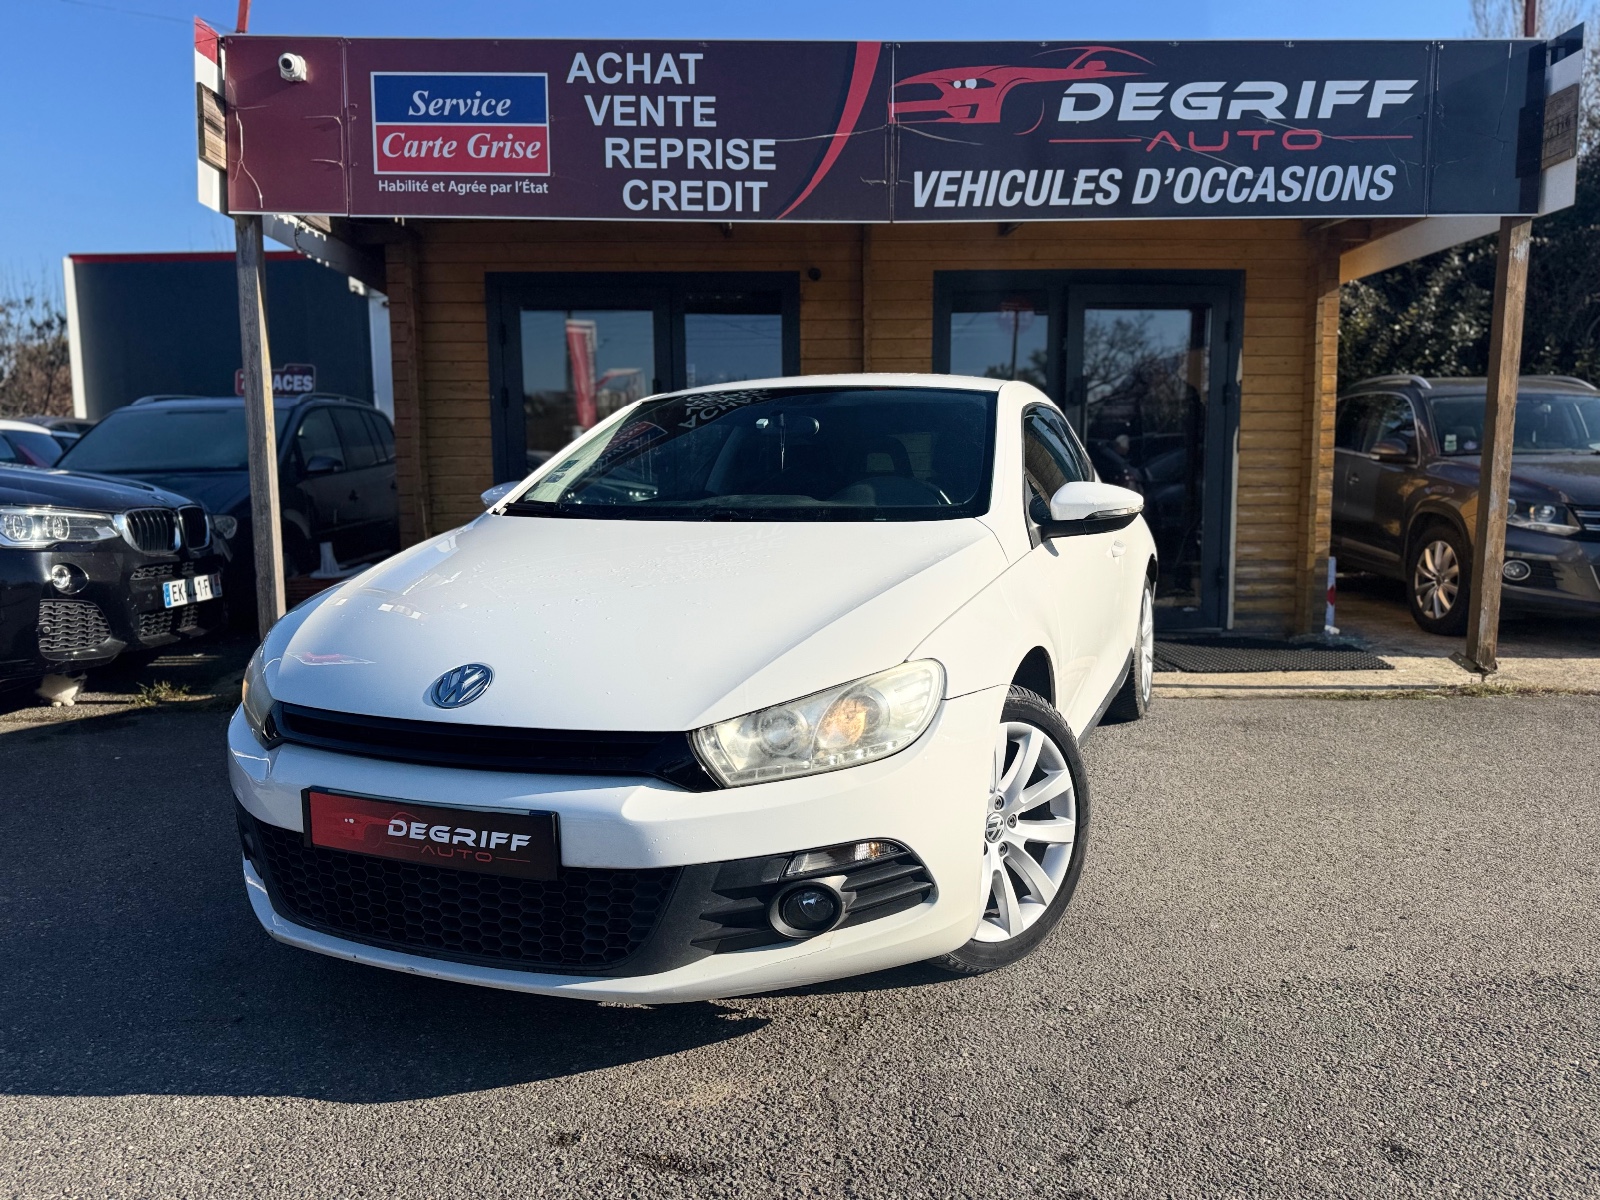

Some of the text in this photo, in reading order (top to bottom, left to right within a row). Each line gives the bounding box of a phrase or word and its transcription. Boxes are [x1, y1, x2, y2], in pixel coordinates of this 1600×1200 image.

[567, 52, 704, 85] ACHAT
[408, 90, 511, 118] Service
[585, 94, 717, 128] VENTE
[1058, 79, 1419, 124] DEGRIFF
[382, 131, 541, 161] Carte Grise
[605, 137, 777, 171] REPRISE
[1146, 130, 1322, 152] AUTO
[378, 179, 429, 193] Habilité
[432, 181, 446, 193] et
[448, 180, 487, 196] Agrée
[490, 183, 513, 196] par
[623, 179, 769, 212] CREDIT
[913, 163, 1396, 208] VEHICULES D'OCCASIONS
[273, 374, 314, 392] ACES
[431, 663, 493, 709] VW
[387, 819, 532, 852] DEGRIFF
[421, 845, 493, 863] AUTO
